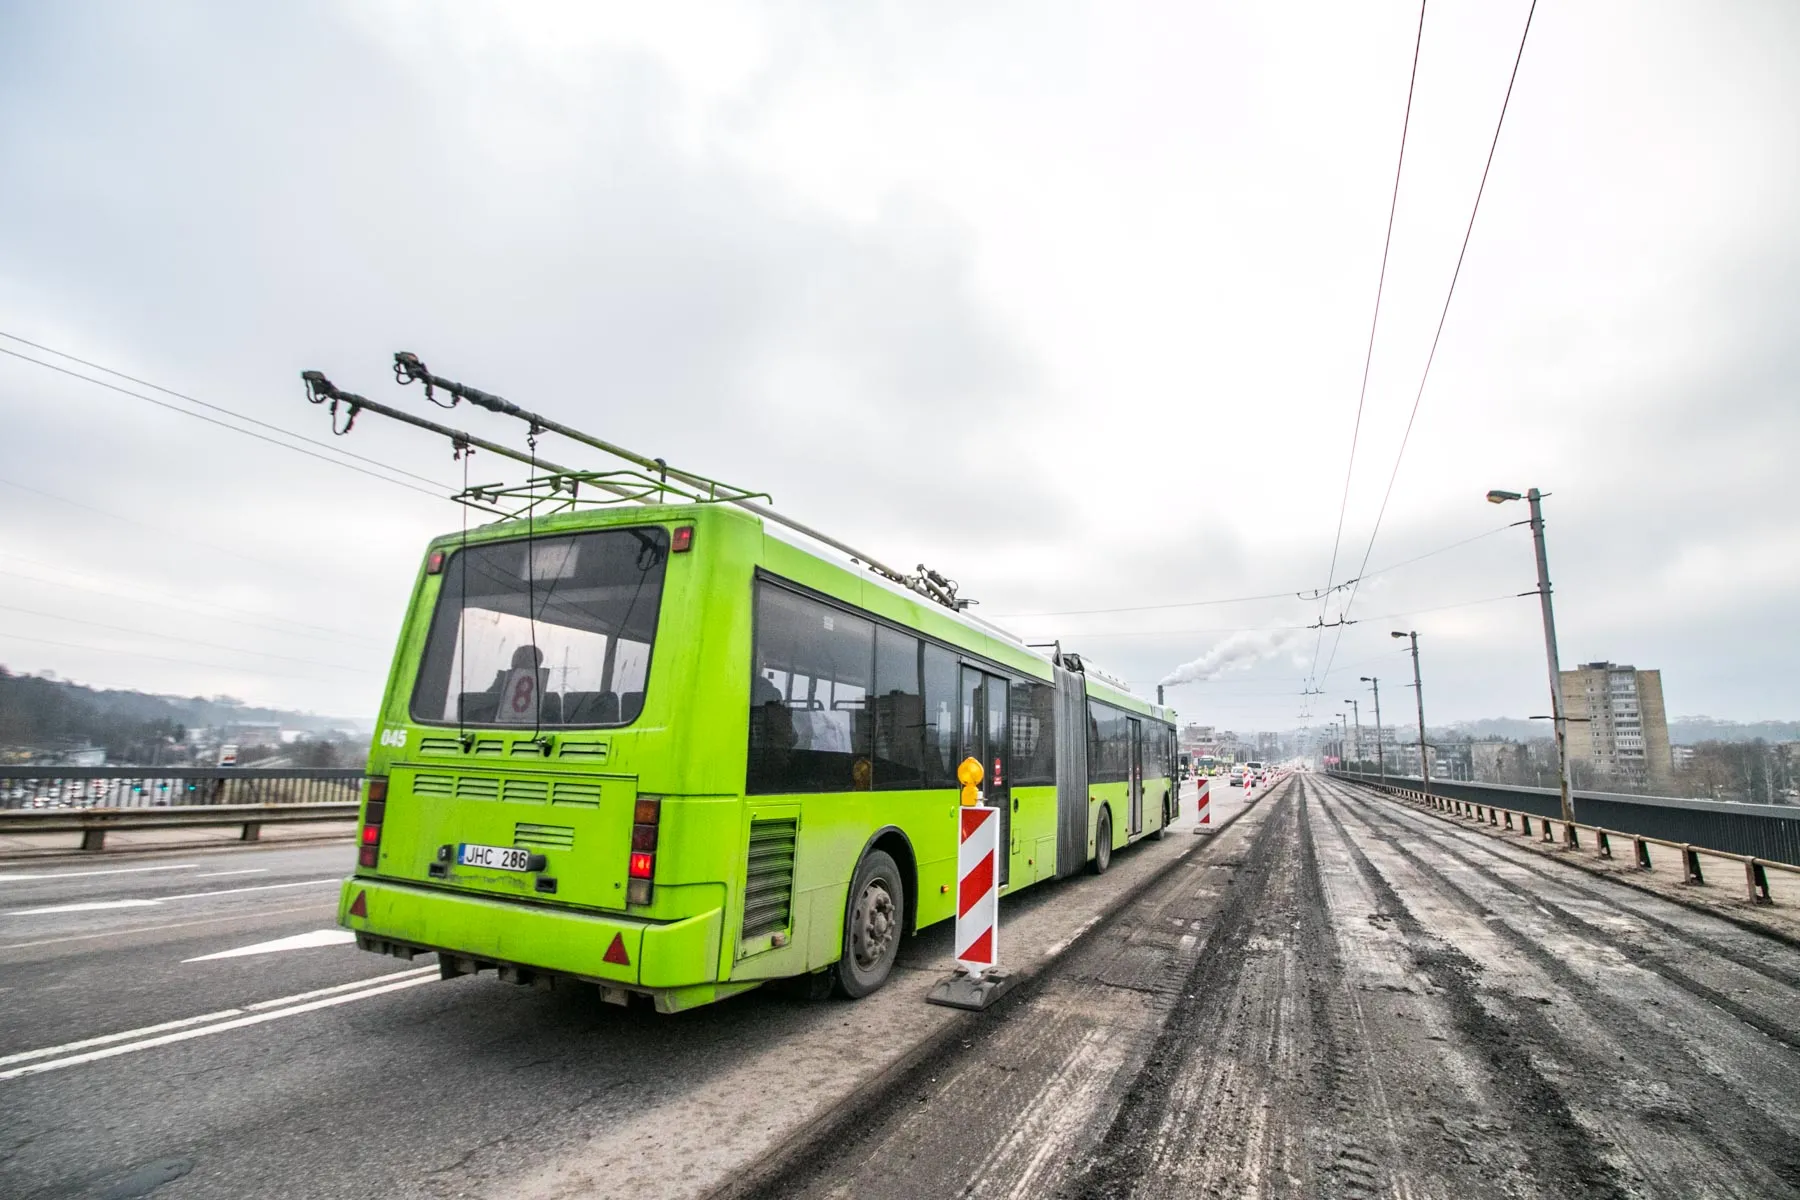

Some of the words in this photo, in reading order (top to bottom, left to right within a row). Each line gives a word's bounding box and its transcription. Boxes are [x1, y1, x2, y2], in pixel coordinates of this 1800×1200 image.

[512, 676, 534, 713] 8
[380, 729, 408, 748] 045
[466, 847, 493, 865] JHC
[501, 850, 527, 869] 286
